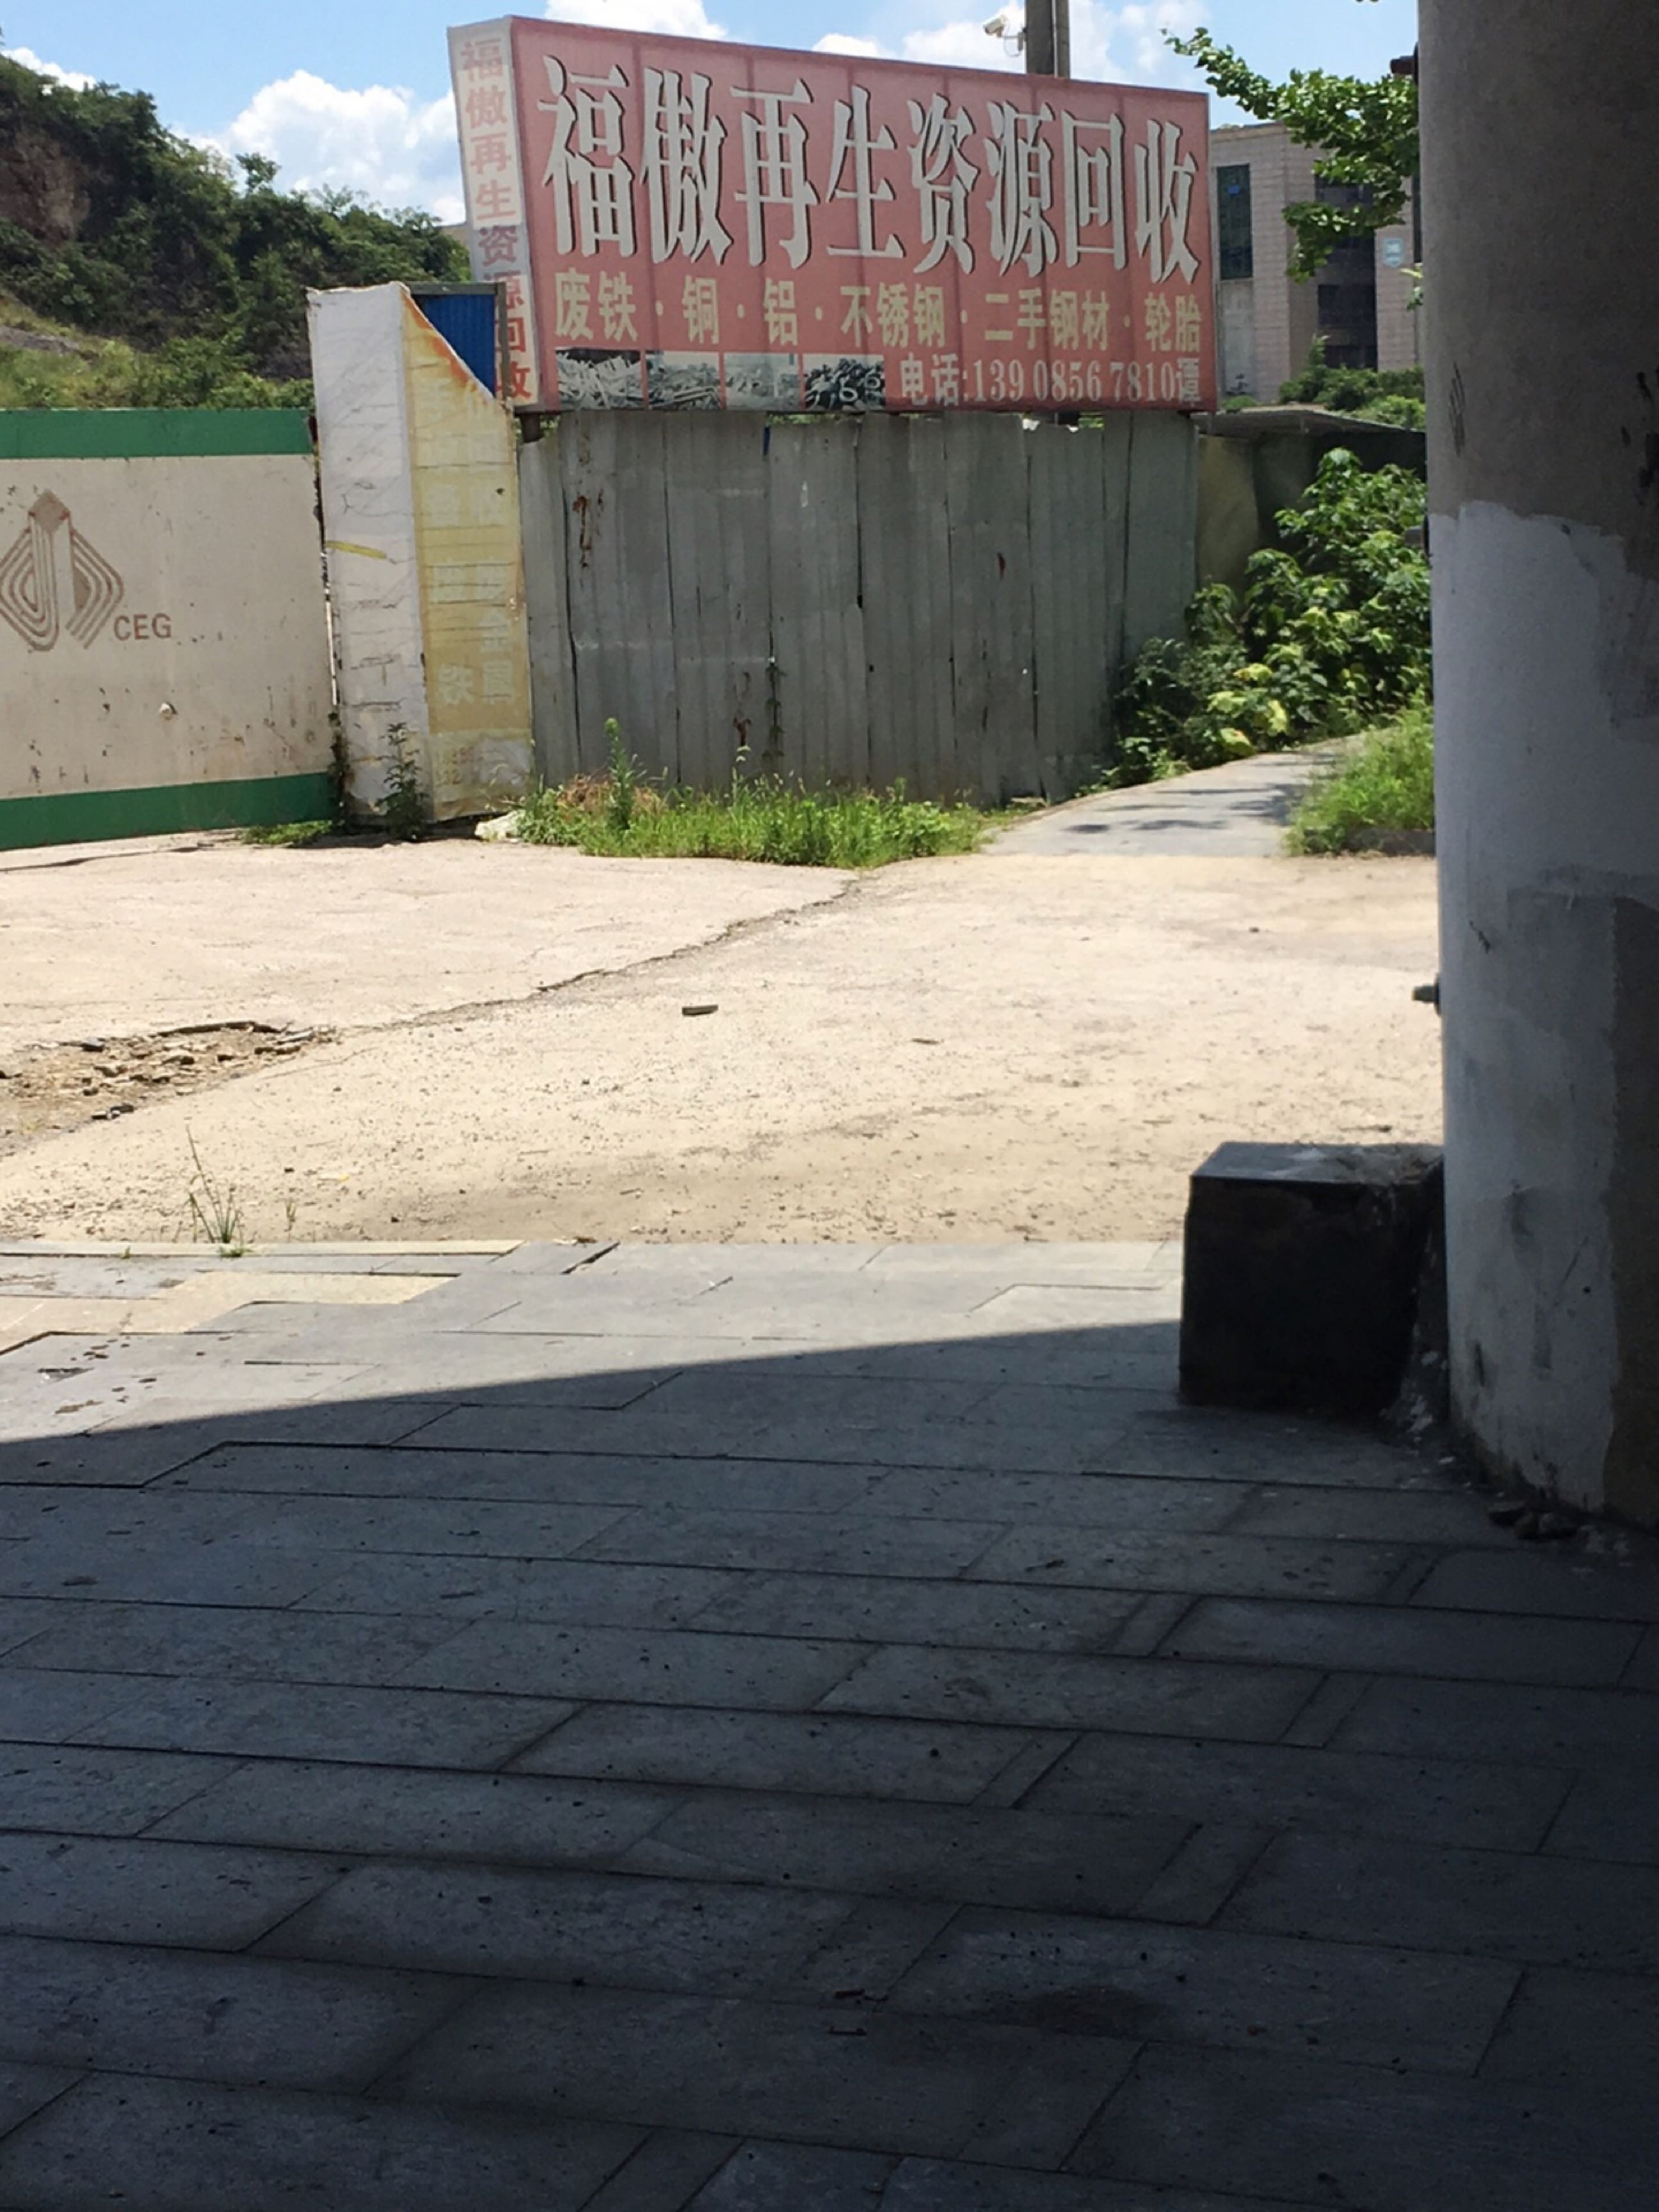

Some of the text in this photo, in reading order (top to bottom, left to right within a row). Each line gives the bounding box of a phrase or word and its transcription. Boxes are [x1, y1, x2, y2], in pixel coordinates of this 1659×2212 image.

[538, 54, 1201, 284] 福傲再生资源回收
[114, 613, 172, 641] CEG
